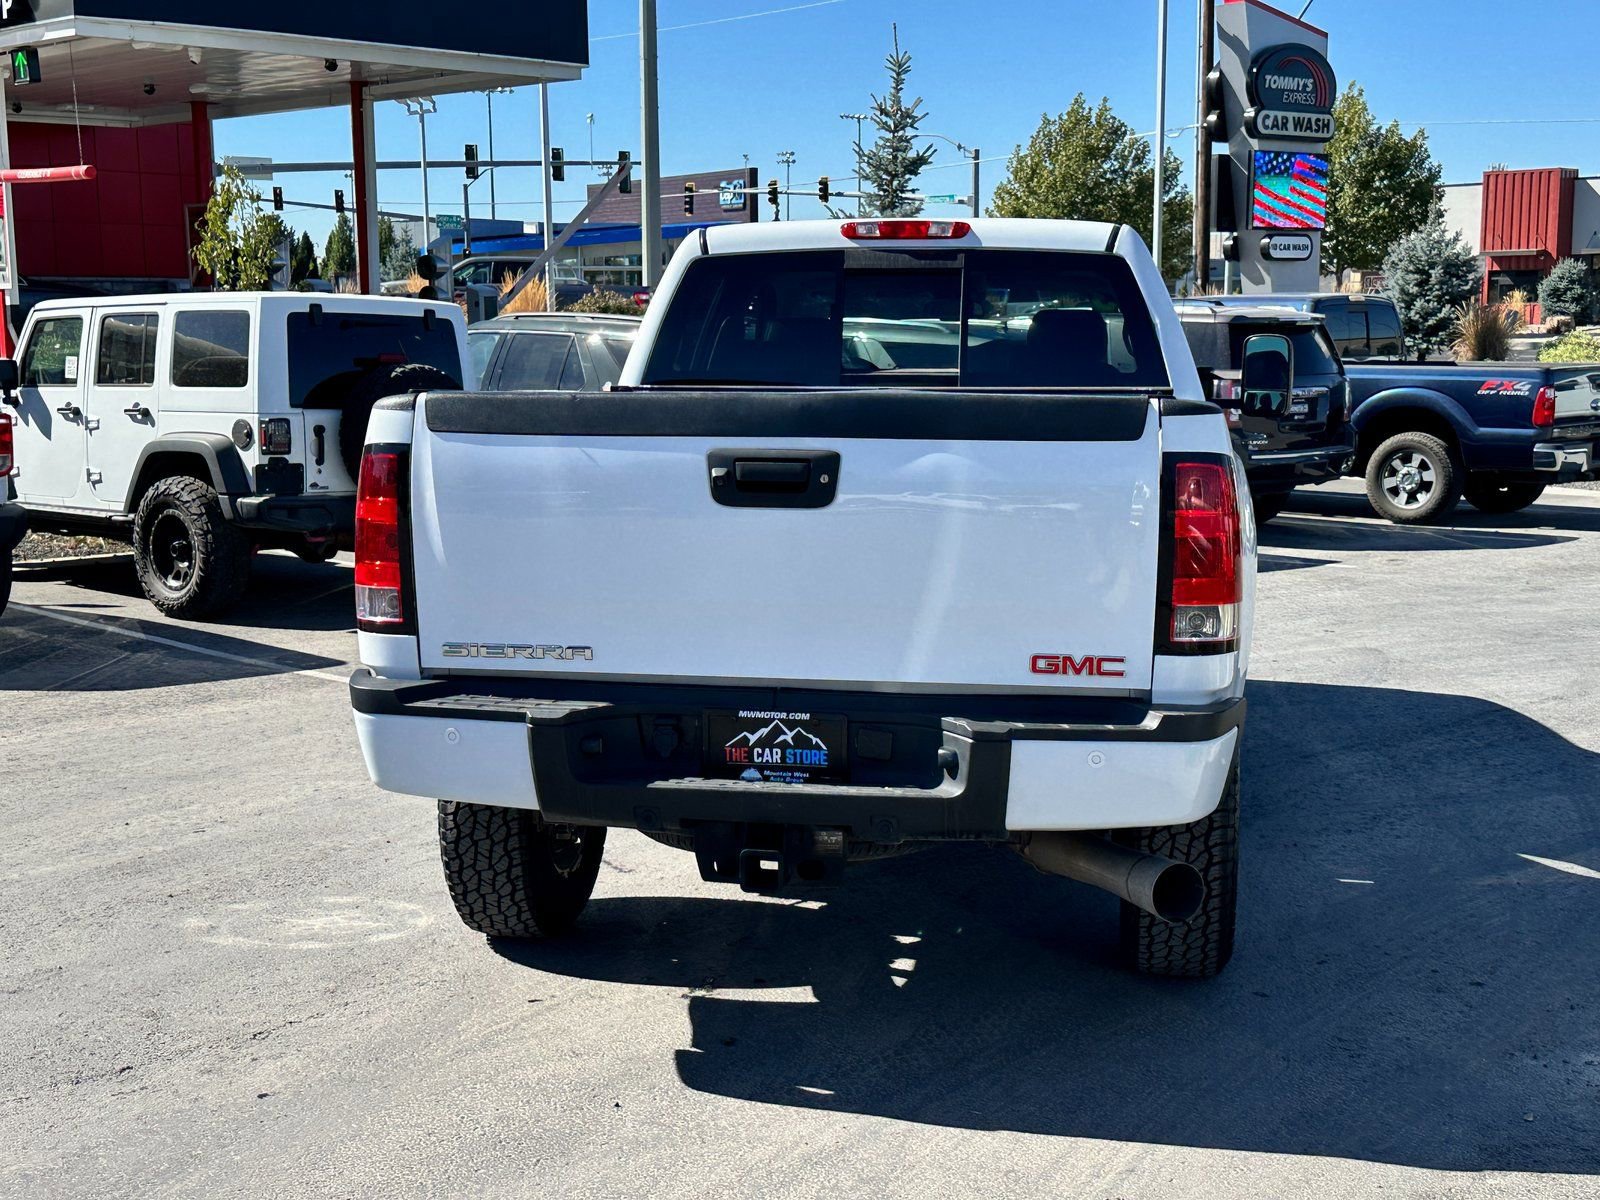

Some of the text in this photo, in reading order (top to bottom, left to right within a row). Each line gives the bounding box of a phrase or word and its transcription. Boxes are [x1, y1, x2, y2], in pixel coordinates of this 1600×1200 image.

[1264, 74, 1314, 91] TOMMY'S
[1282, 92, 1316, 104] EXPRESS
[1261, 113, 1330, 134] CAR WASH
[1278, 243, 1291, 251] CAR
[1292, 243, 1309, 251] WASH
[1479, 380, 1532, 391] FX4
[442, 641, 594, 661] SIERRA
[1030, 653, 1127, 677] GMC
[738, 710, 811, 721] MWMOTOR.COM
[725, 747, 828, 765] THE CAR STORE
